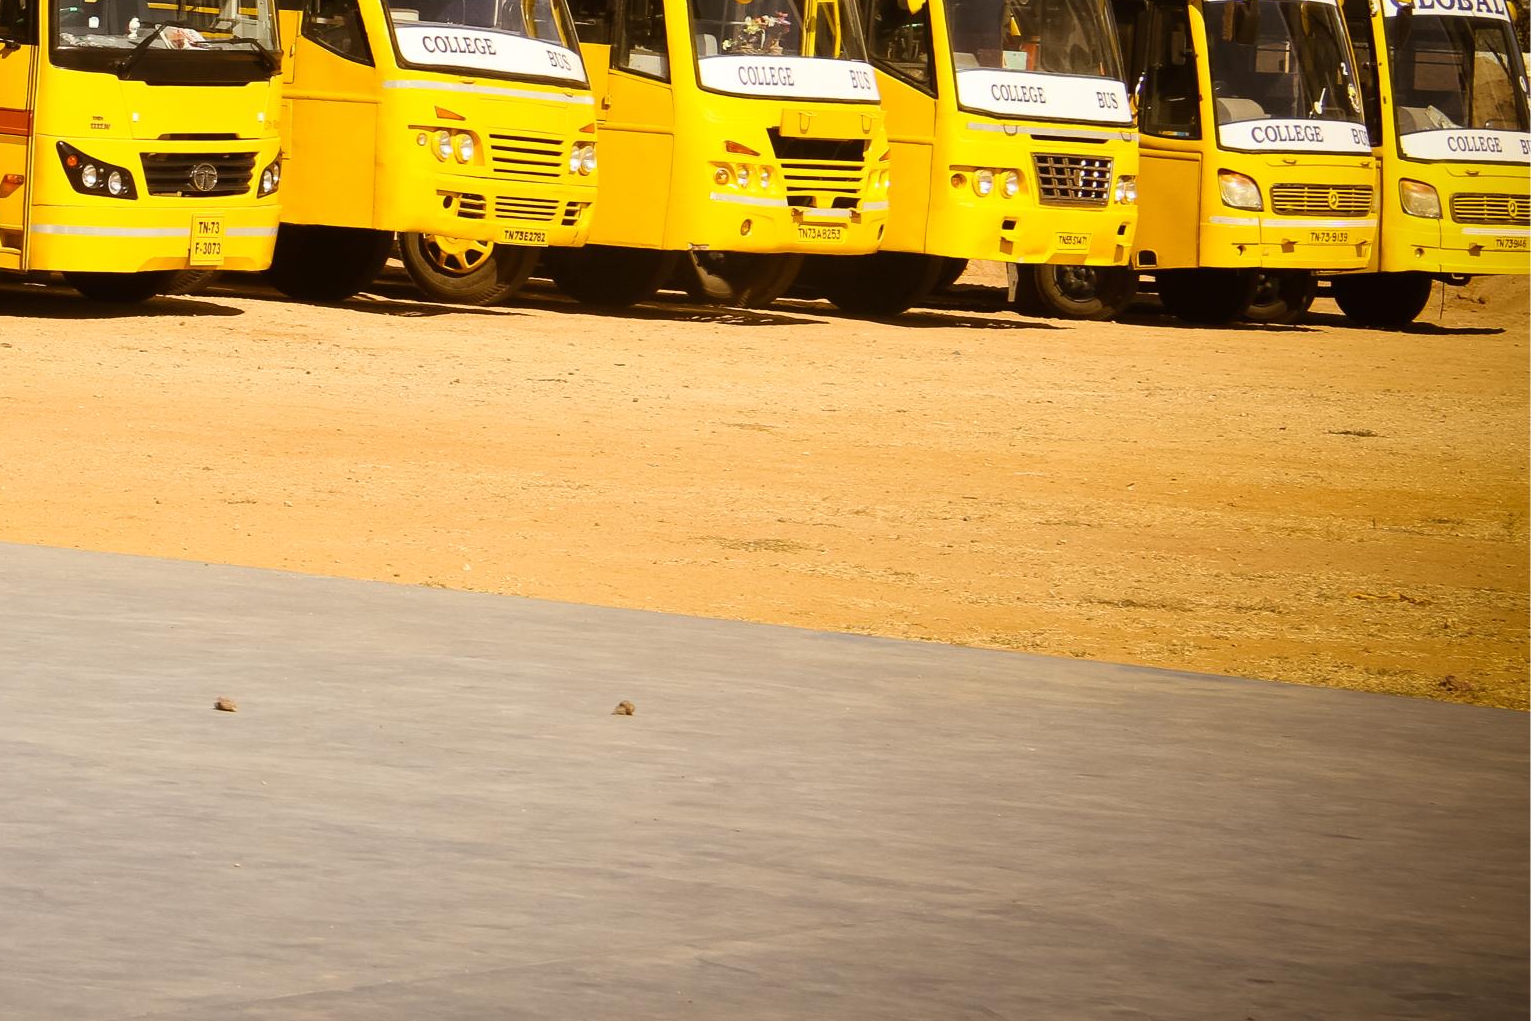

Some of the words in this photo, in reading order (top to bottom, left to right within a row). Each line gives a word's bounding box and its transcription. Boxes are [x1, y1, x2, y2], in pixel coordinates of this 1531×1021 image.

[422, 35, 497, 56] COLLEGE
[546, 49, 572, 71] BUS
[738, 66, 795, 87] COLLEGE
[849, 69, 871, 90] BUS
[991, 84, 1047, 104] COLLEGE
[1096, 91, 1119, 109] BUS
[1251, 125, 1324, 143] COLLEGE
[1447, 136, 1503, 153] COLLEGE
[198, 221, 220, 234] TN-73
[195, 242, 221, 255] F-3073
